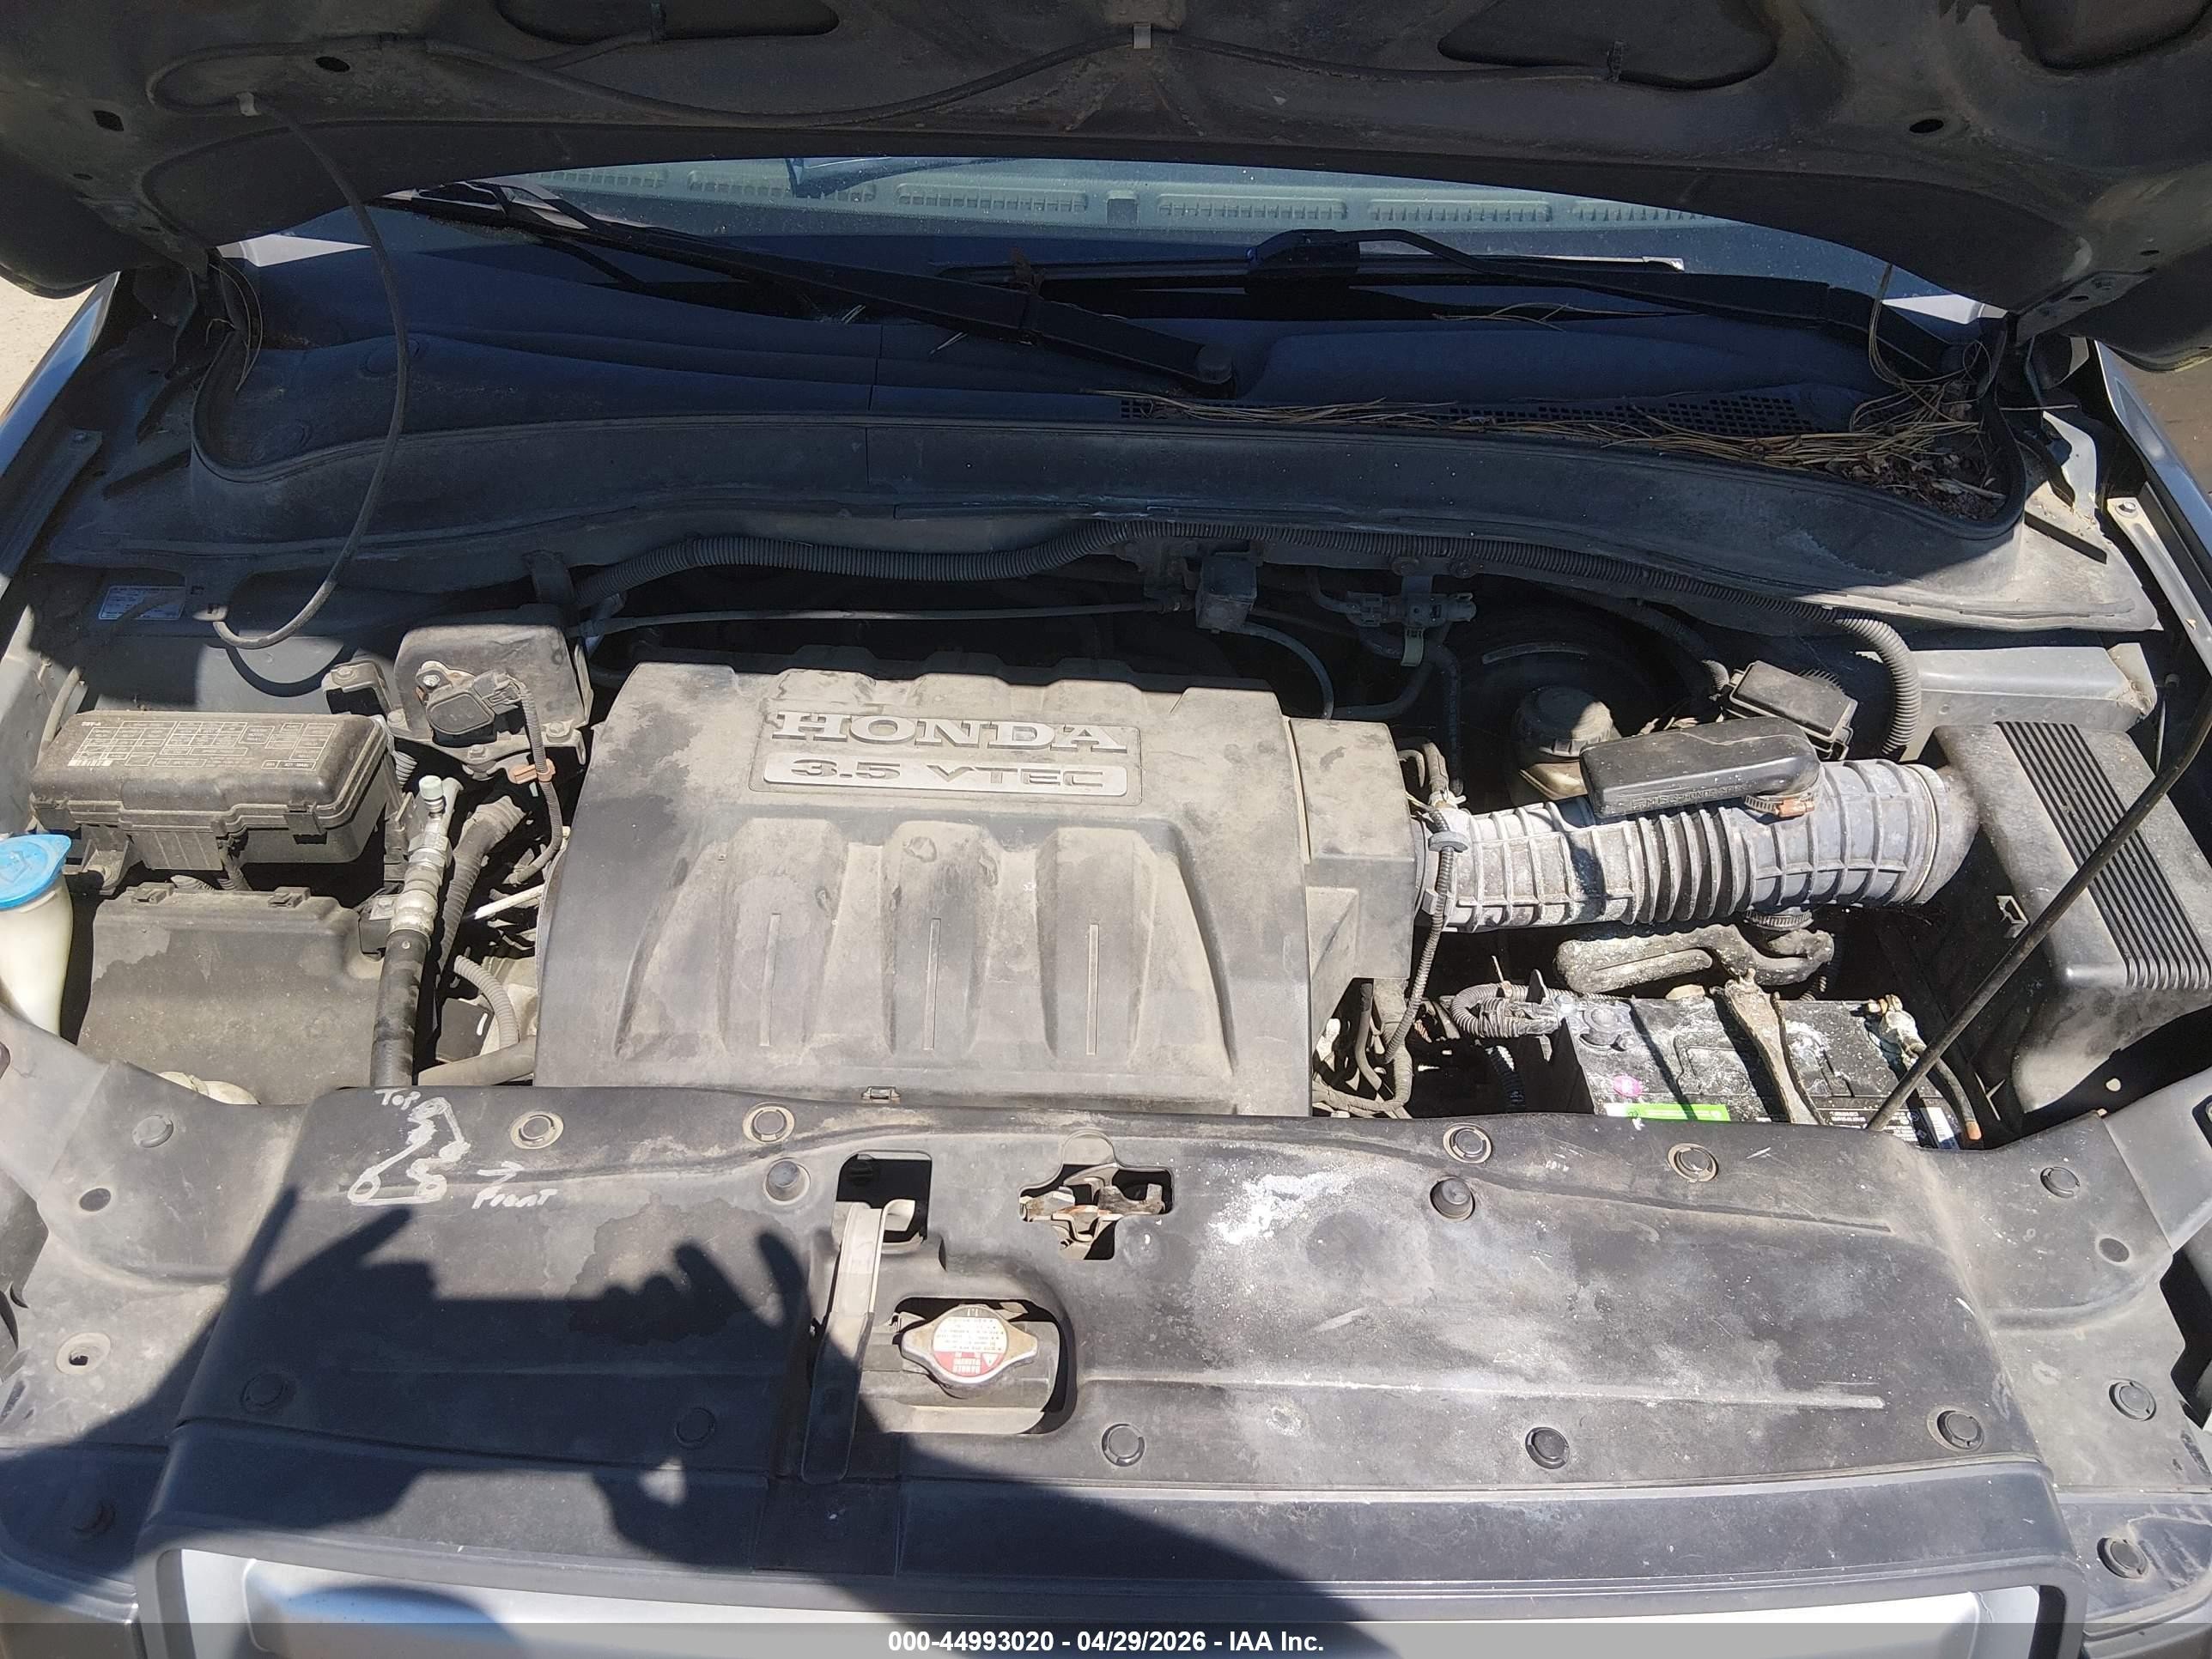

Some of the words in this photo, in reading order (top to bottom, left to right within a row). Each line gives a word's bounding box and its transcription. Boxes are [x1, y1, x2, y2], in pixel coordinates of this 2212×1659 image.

[771, 710, 1128, 752] HONDA
[790, 757, 902, 781] 3.5
[927, 763, 1103, 788] VTEC
